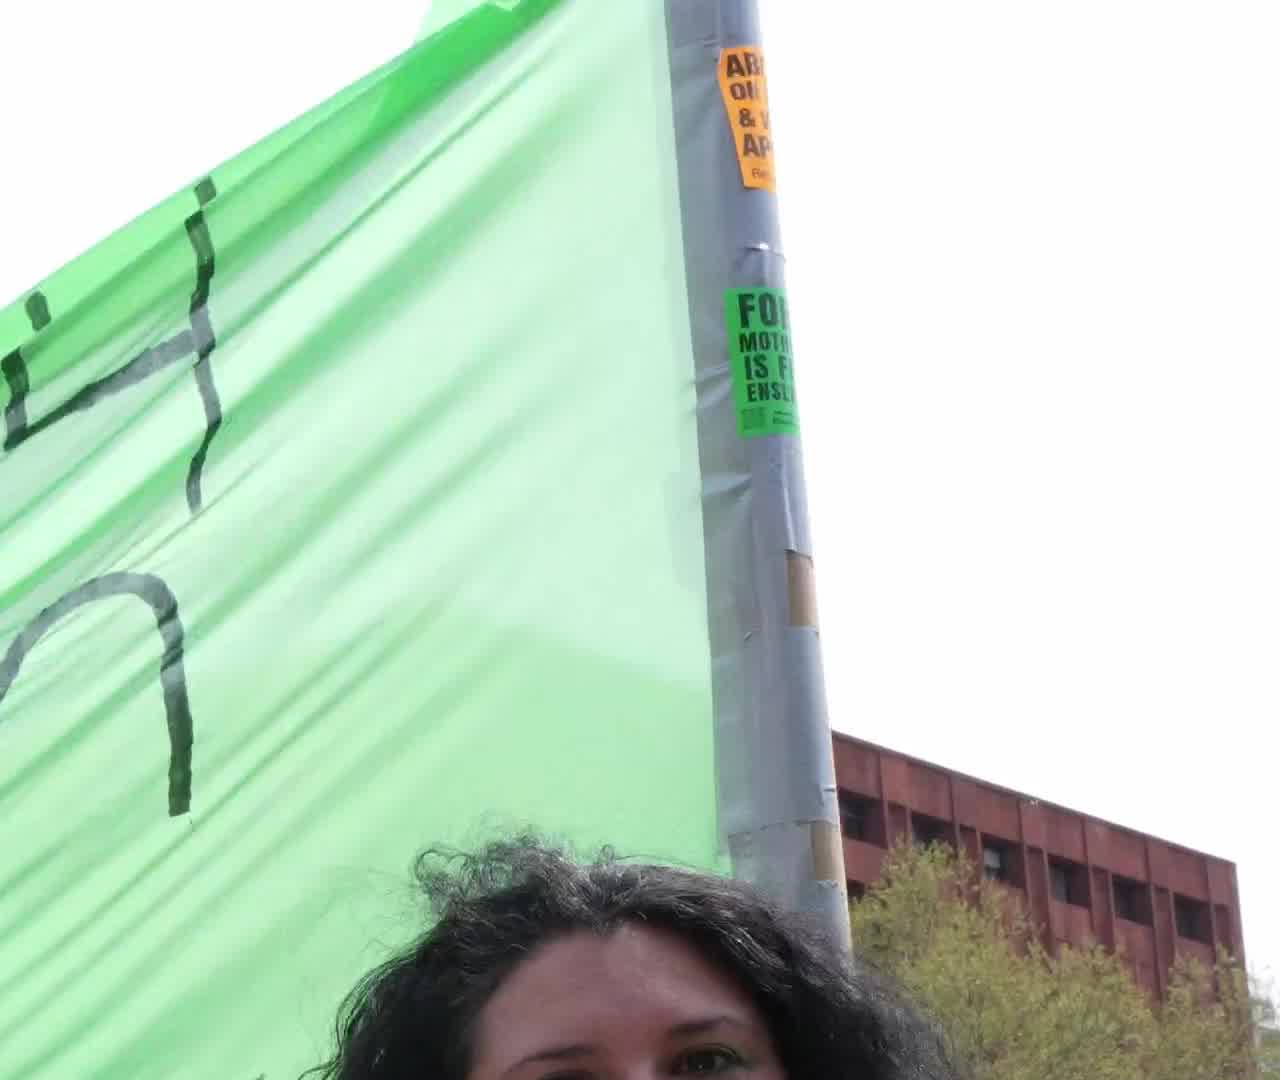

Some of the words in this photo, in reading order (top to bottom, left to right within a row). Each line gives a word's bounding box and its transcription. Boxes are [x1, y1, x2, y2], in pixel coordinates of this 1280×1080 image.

[726, 52, 766, 78] AB
[2, 175, 223, 516] 4
[743, 354, 769, 381] IS
